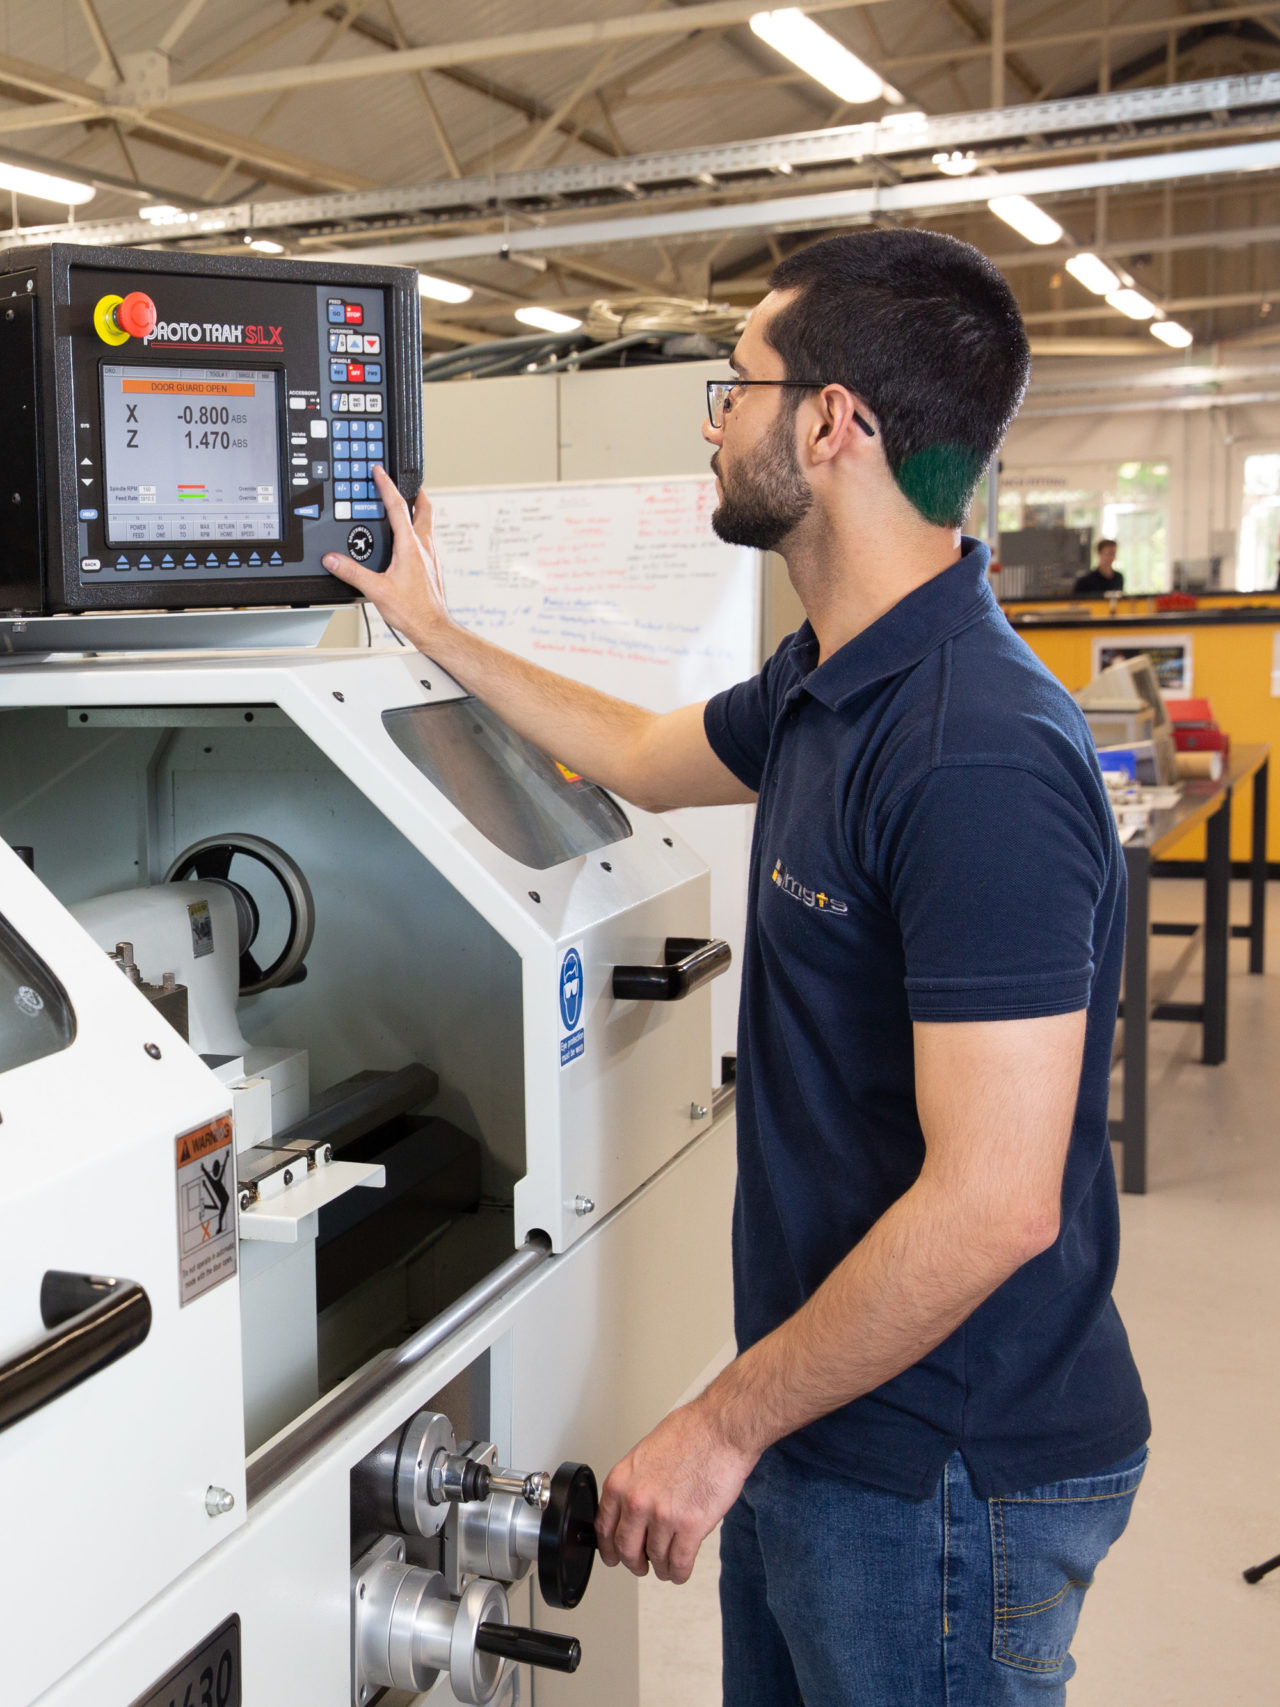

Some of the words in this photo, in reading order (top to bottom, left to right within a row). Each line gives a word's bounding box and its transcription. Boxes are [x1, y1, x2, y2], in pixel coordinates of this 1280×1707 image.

[245, 325, 283, 345] SLX
[151, 383, 174, 391] DOOR
[176, 384, 204, 392] GUARD
[206, 384, 228, 393] OPEN
[126, 404, 138, 423] X
[177, 406, 229, 424] -0.800
[231, 415, 247, 423] ABS
[127, 430, 138, 448] Z
[184, 431, 230, 449] 1.470
[232, 439, 247, 447] ABS
[317, 466, 323, 474] Z
[196, 1256, 211, 1270] operate
[185, 1277, 196, 1288] mode
